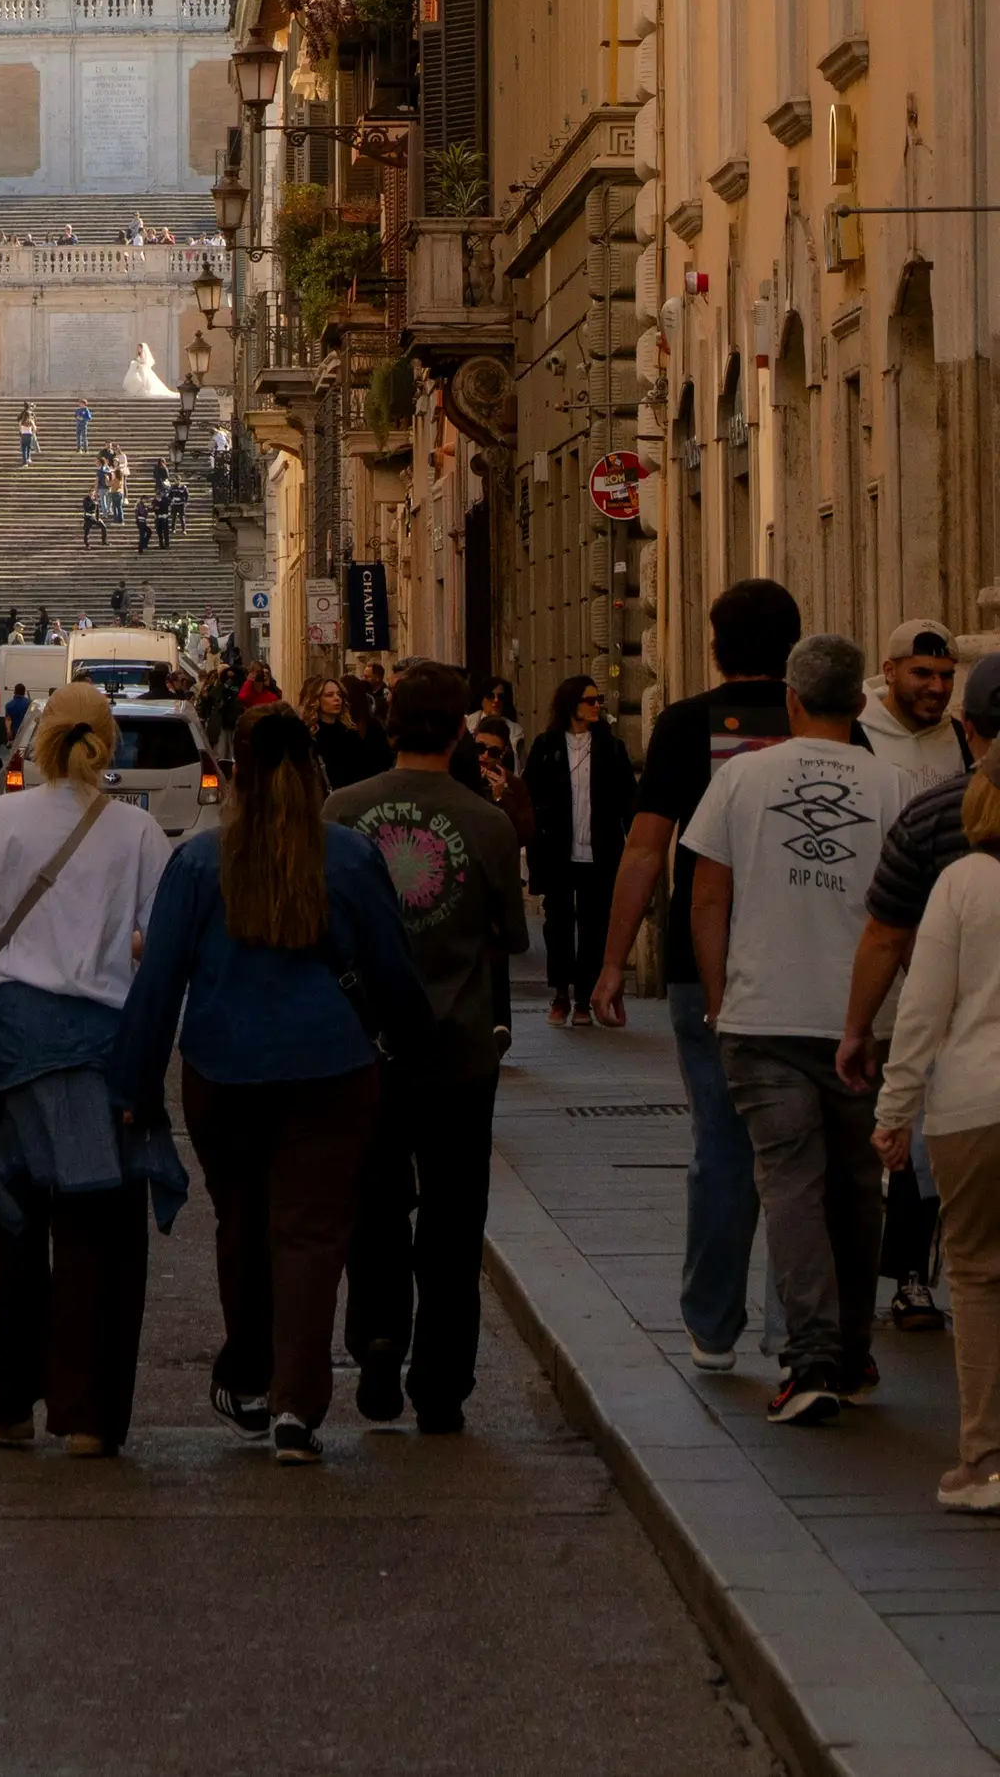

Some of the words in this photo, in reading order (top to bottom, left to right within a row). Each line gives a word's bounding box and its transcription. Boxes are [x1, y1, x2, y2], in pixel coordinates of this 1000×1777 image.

[362, 570, 377, 647] CHAUMET
[789, 867, 811, 887] RIP
[815, 869, 847, 892] CURL
